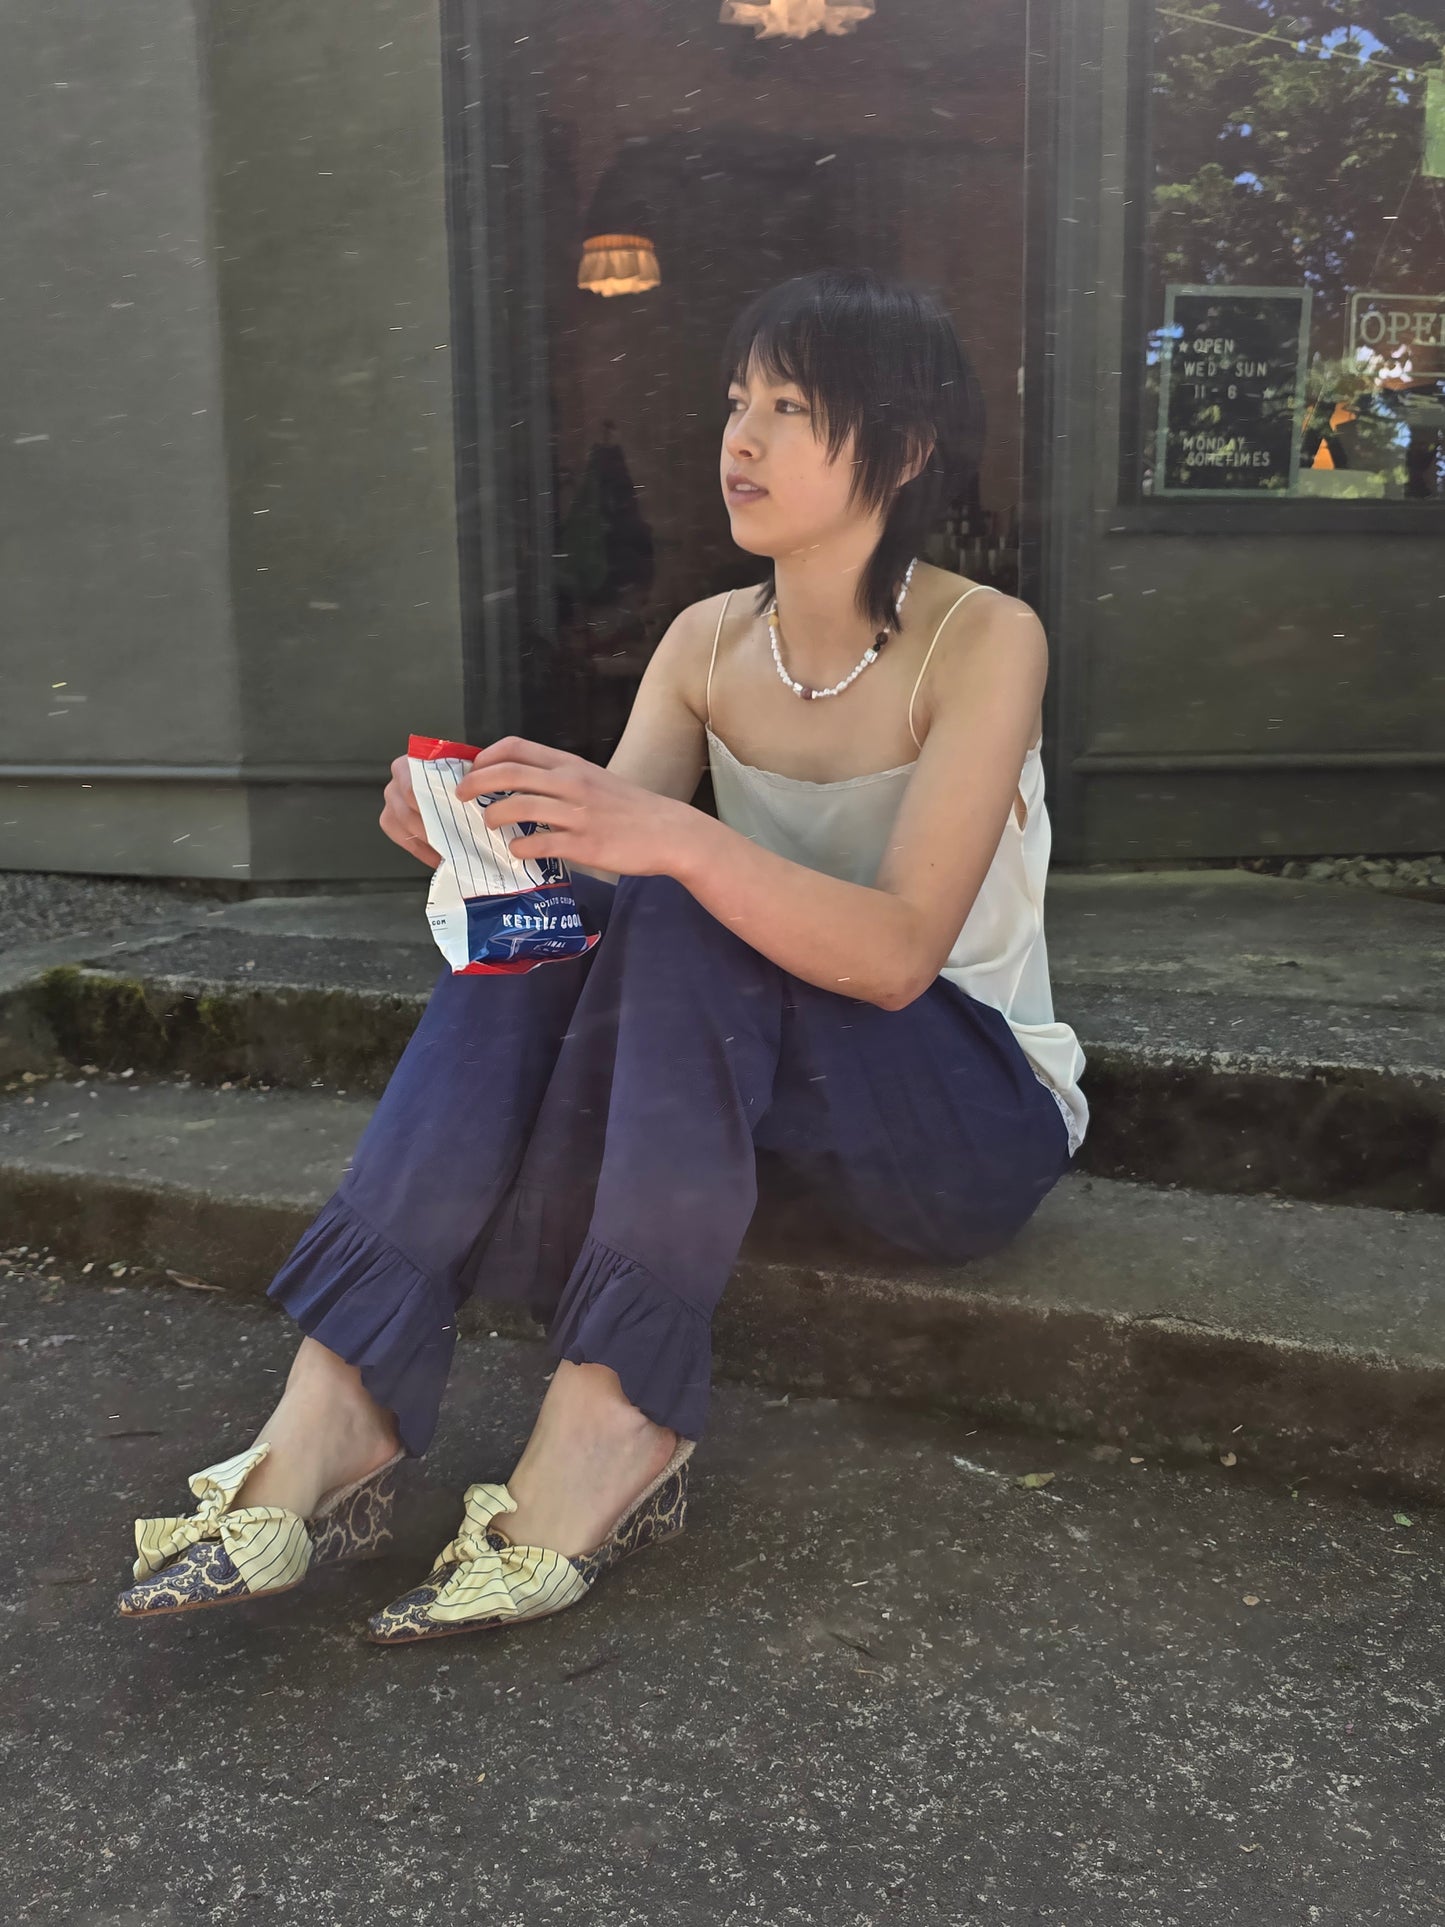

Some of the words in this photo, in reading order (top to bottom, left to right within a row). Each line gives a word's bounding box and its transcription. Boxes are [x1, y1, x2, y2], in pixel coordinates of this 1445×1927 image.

[1192, 338, 1235, 354] OPEN
[1184, 361, 1217, 377] WED
[1235, 361, 1267, 377] SUN
[1183, 436, 1246, 451] MONDAY
[1186, 451, 1270, 467] SOMETIMES
[502, 914, 558, 931] KETTLE
